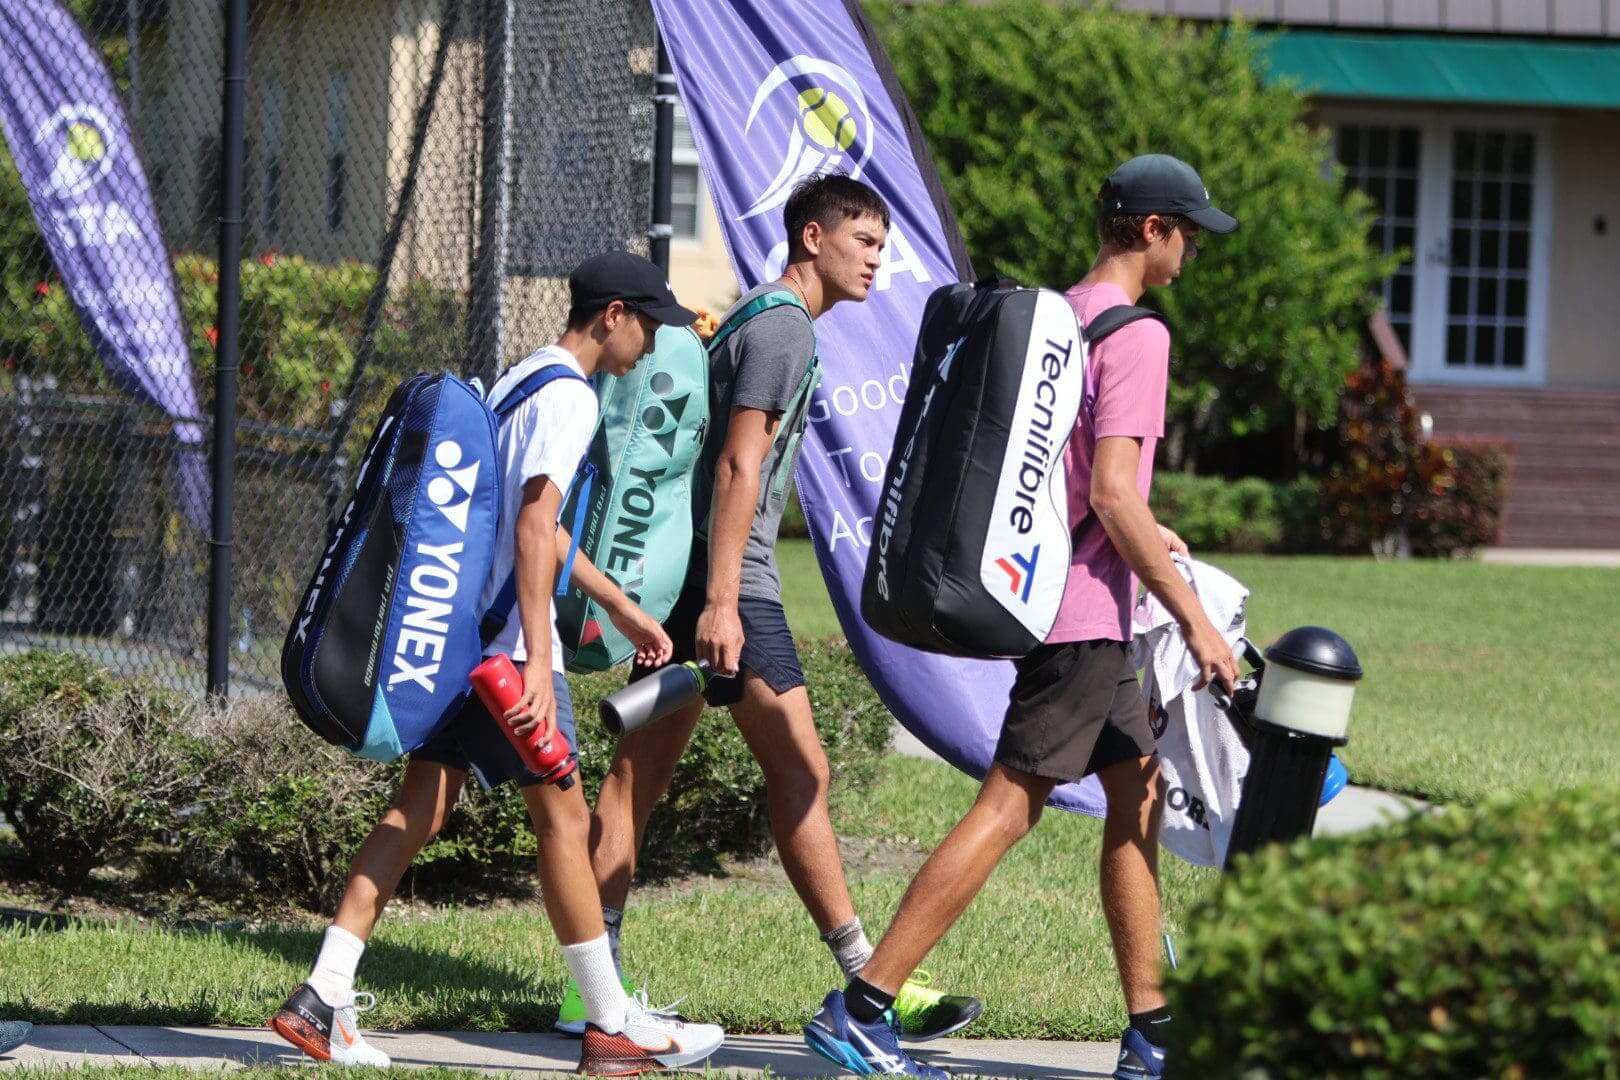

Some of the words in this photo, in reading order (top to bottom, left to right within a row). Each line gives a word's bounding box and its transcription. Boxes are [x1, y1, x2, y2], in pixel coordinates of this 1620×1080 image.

[1010, 338, 1072, 534] Tecnifibre
[364, 593, 387, 687] performance
[384, 564, 394, 593] pro
[388, 542, 464, 694] YONEX
